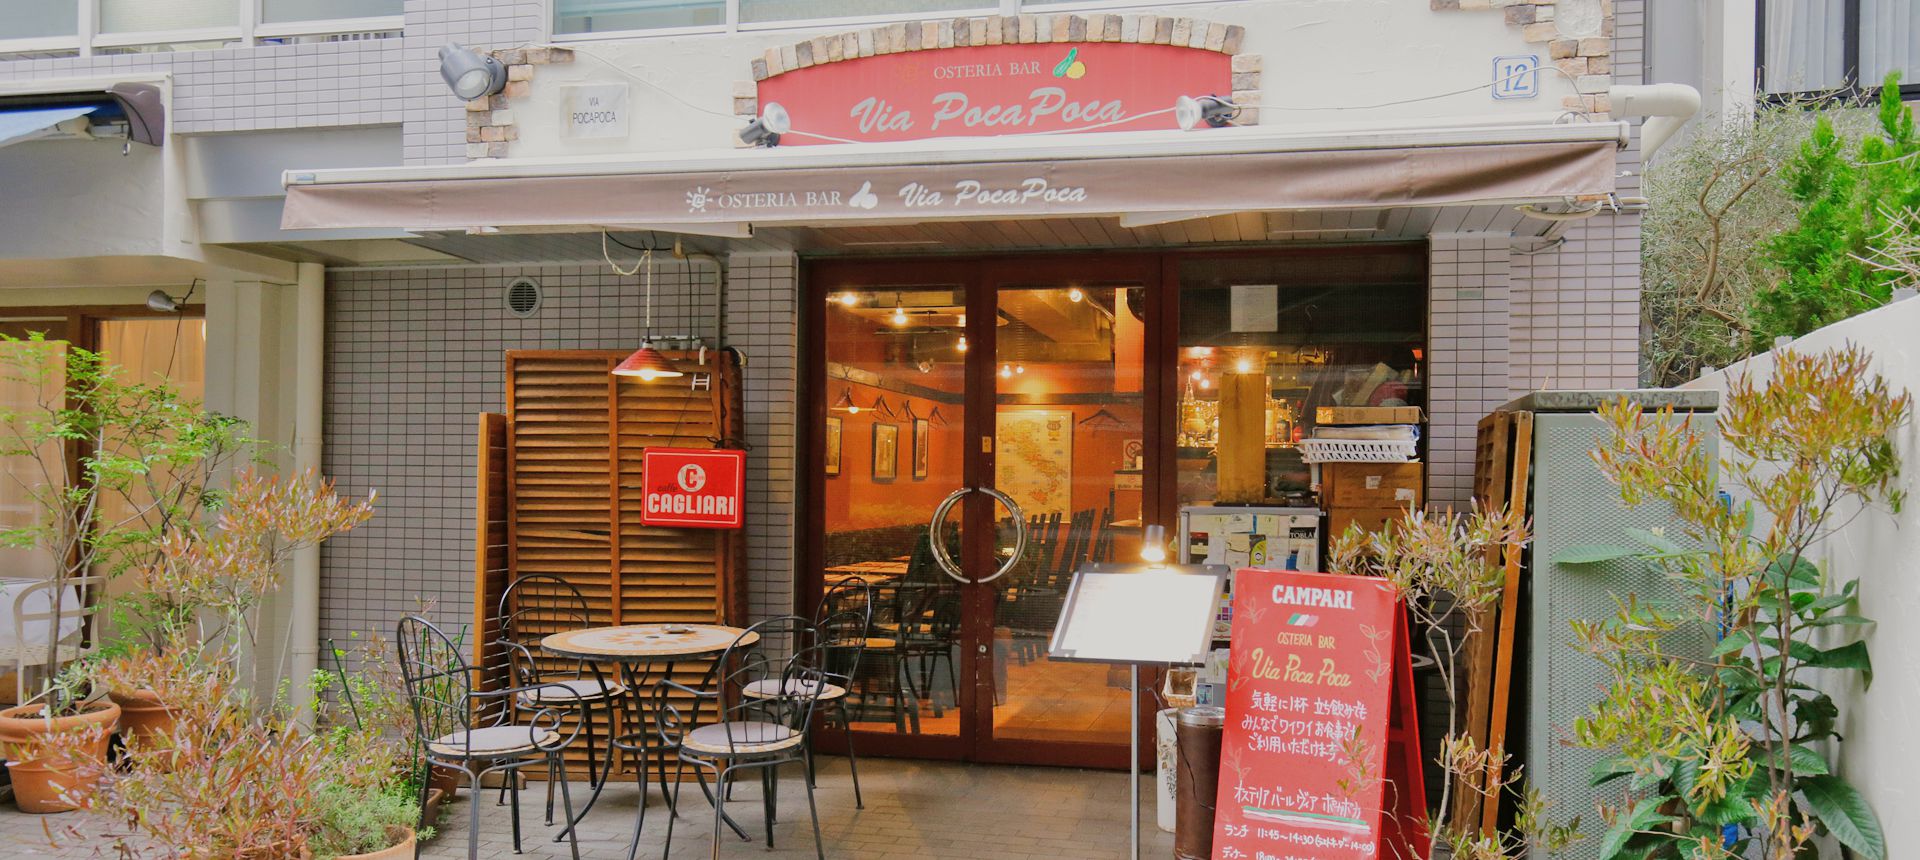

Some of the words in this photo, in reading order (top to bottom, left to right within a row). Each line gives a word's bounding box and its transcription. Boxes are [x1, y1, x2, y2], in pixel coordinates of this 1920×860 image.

[933, 63, 1002, 80] OSTERIA
[1009, 61, 1041, 76] BAR
[1503, 64, 1528, 91] 12
[588, 96, 600, 106] VIA
[573, 111, 617, 124] POCAPOCA
[850, 96, 915, 134] Via
[718, 191, 798, 209] OSTERIA
[806, 190, 842, 207] BAR
[899, 182, 944, 207] Via
[647, 493, 735, 515] CAGLIARI
[1272, 584, 1354, 609] CAMPARI
[1277, 631, 1313, 647] OSTERIA
[1318, 635, 1336, 649] BAR
[1251, 648, 1281, 680] Via
[1284, 654, 1315, 684] Poca
[1317, 658, 1352, 687] Poca
[1224, 824, 1248, 838] ランチ
[1221, 846, 1248, 860] ディナー
